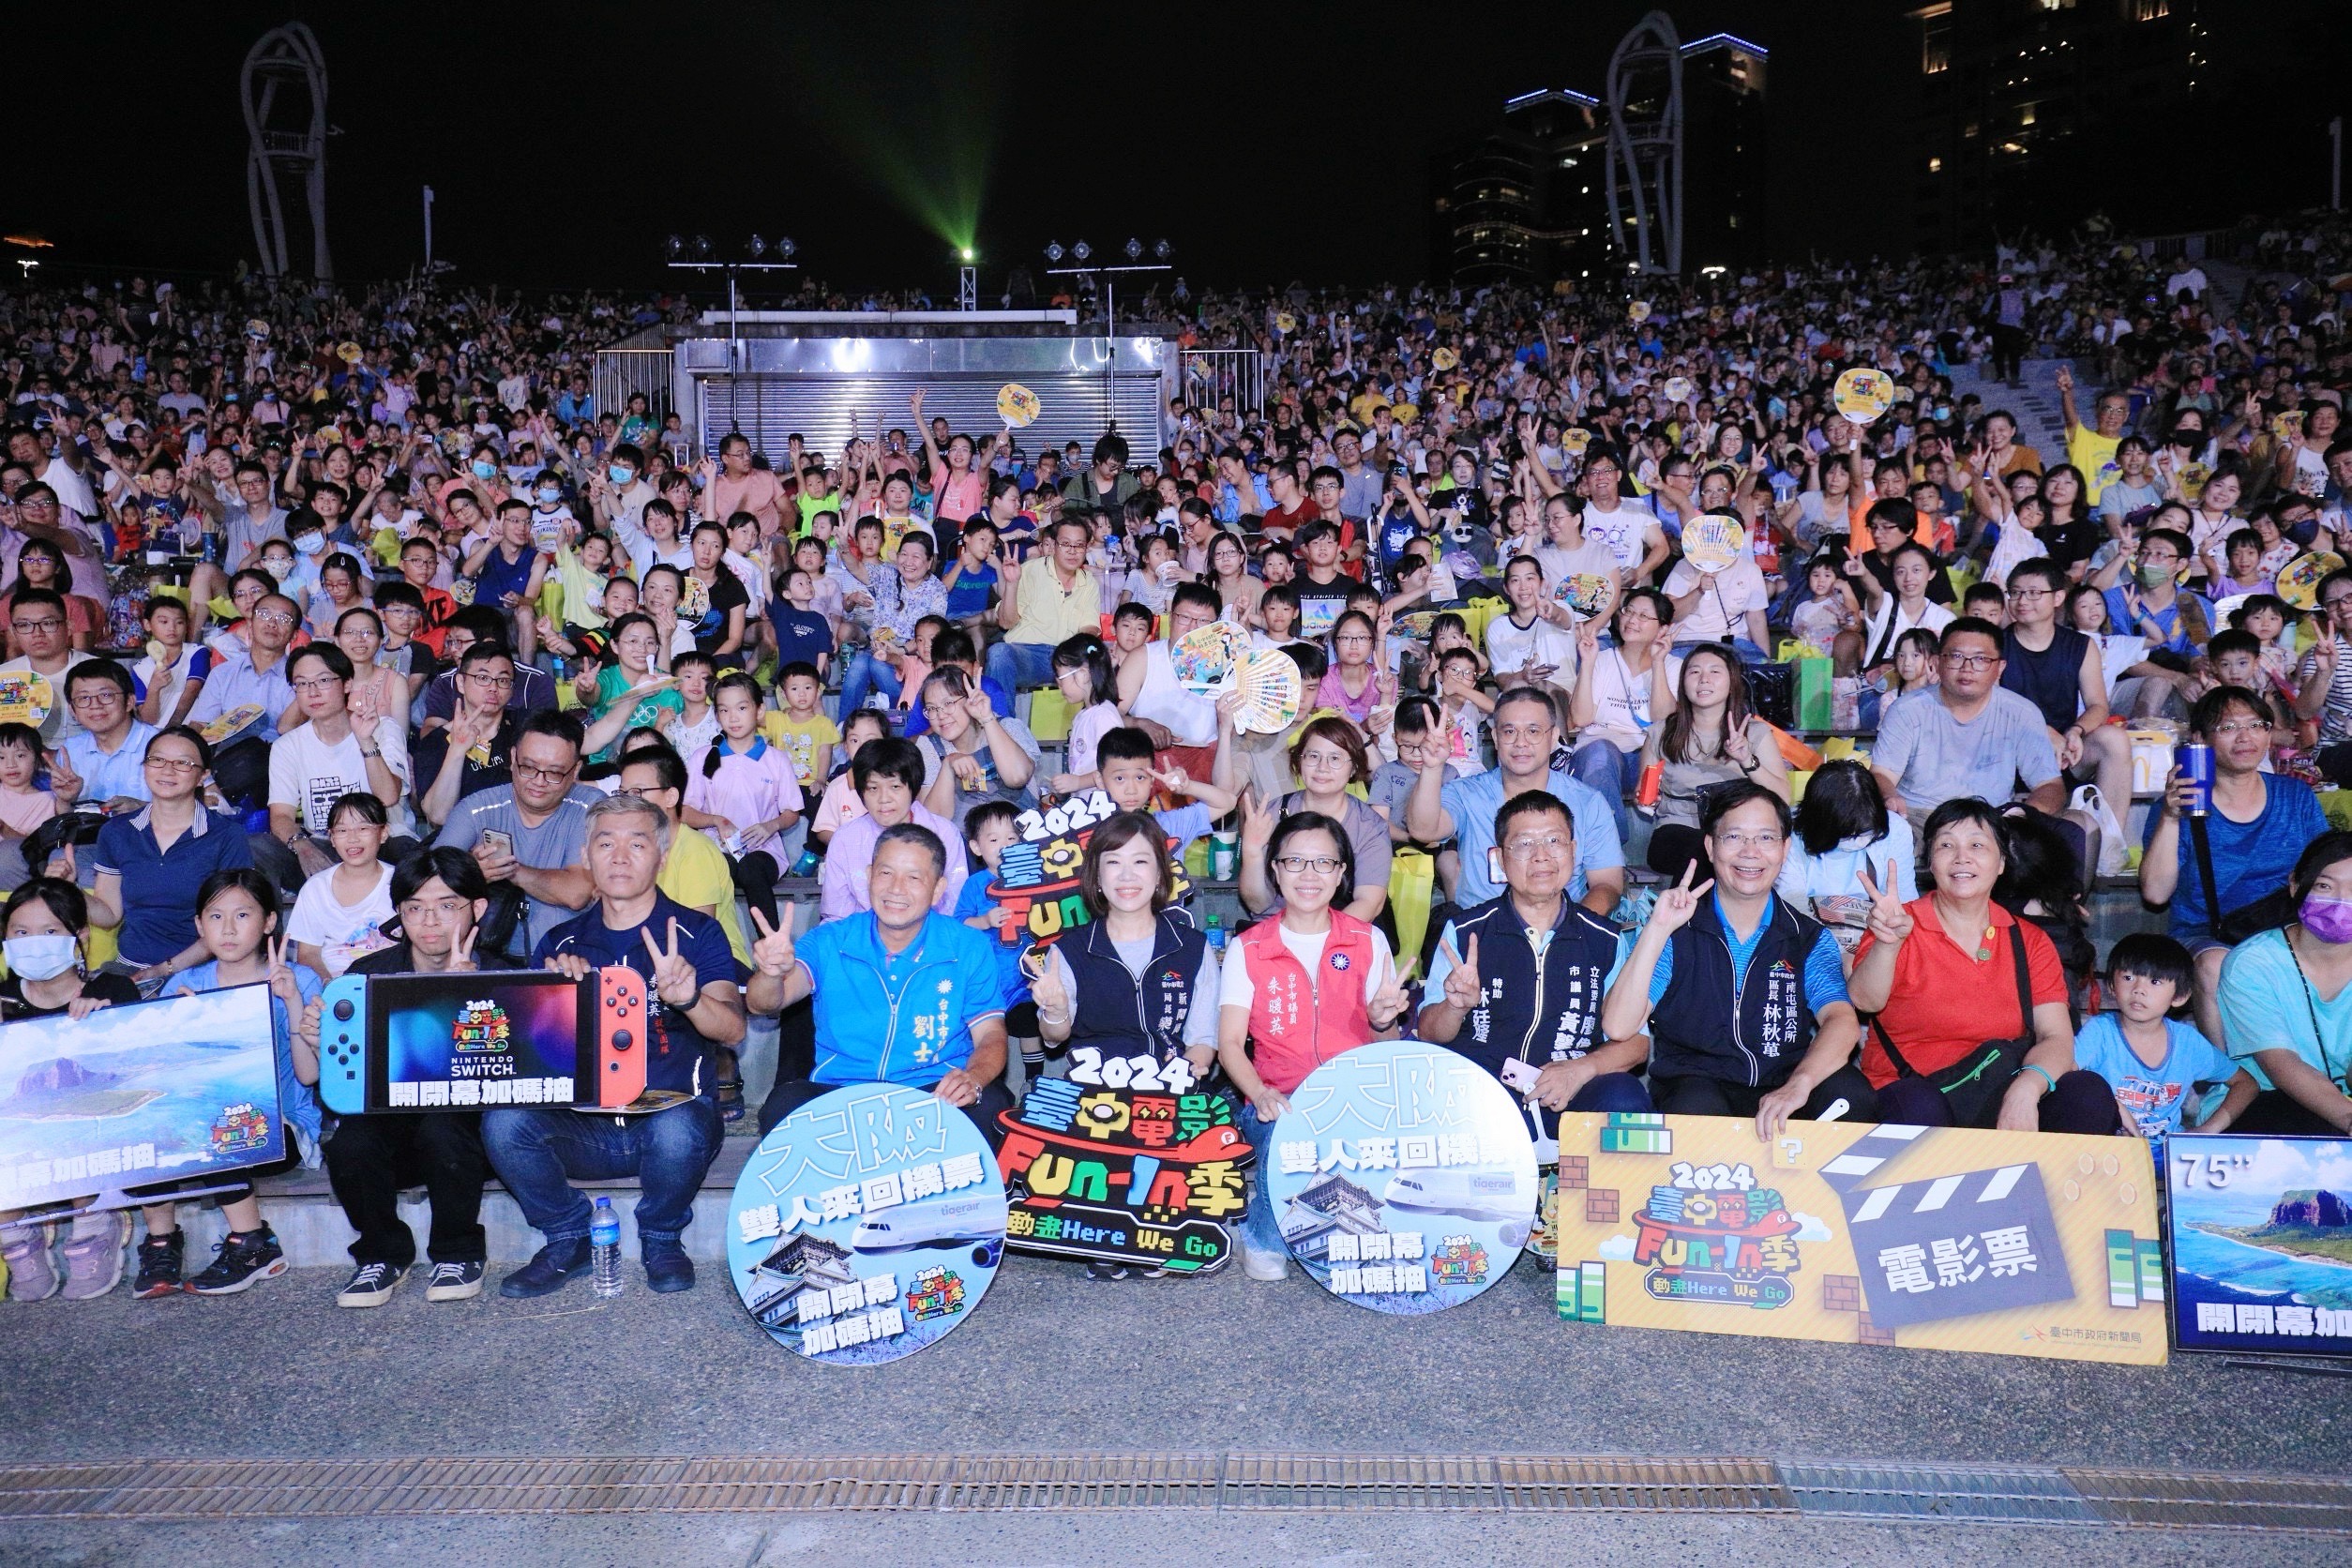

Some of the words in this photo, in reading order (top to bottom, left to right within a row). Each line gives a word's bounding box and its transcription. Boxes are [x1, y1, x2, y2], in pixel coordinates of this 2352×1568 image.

[1016, 791, 1116, 841] 2024
[1287, 972, 1299, 1025] 台中市議員
[1492, 977, 1503, 999] 特助
[466, 999, 496, 1011] 2024
[1267, 976, 1285, 1035] 朱暖英
[1784, 981, 1798, 1044] 南屯區公所
[451, 1055, 514, 1064] NINTENDO
[451, 1063, 513, 1078] SWITCH
[1068, 1046, 1195, 1095] 2024
[388, 1077, 575, 1108] 開閉幕加碼抽
[1302, 1051, 1484, 1136] 大阪
[222, 1102, 253, 1117] 2024
[1020, 1077, 1231, 1147] 臺中電影
[758, 1086, 949, 1198] 大阪
[0, 1142, 157, 1189] 幕加碼抽
[1671, 1161, 1754, 1191] 2024
[738, 1151, 986, 1245] 雙人來回機票
[1472, 1176, 1513, 1190] tigerair
[940, 1201, 981, 1218] tigerair
[1649, 1185, 1783, 1226] 臺中電影
[1137, 1229, 1175, 1252] We
[1184, 1236, 1218, 1258] Go
[1327, 1231, 1425, 1262] 開閉幕
[1442, 1234, 1473, 1246] 2024
[915, 1264, 947, 1281] 2024
[1877, 1224, 2039, 1296] 電影票
[1330, 1265, 1427, 1295] 加碼抽
[1734, 1283, 1758, 1299] We
[1764, 1286, 1786, 1301] Go
[797, 1273, 899, 1324] 開閉幕
[802, 1307, 906, 1357] 加碼抽
[2049, 1325, 2142, 1344] 臺中市政府新聞局
